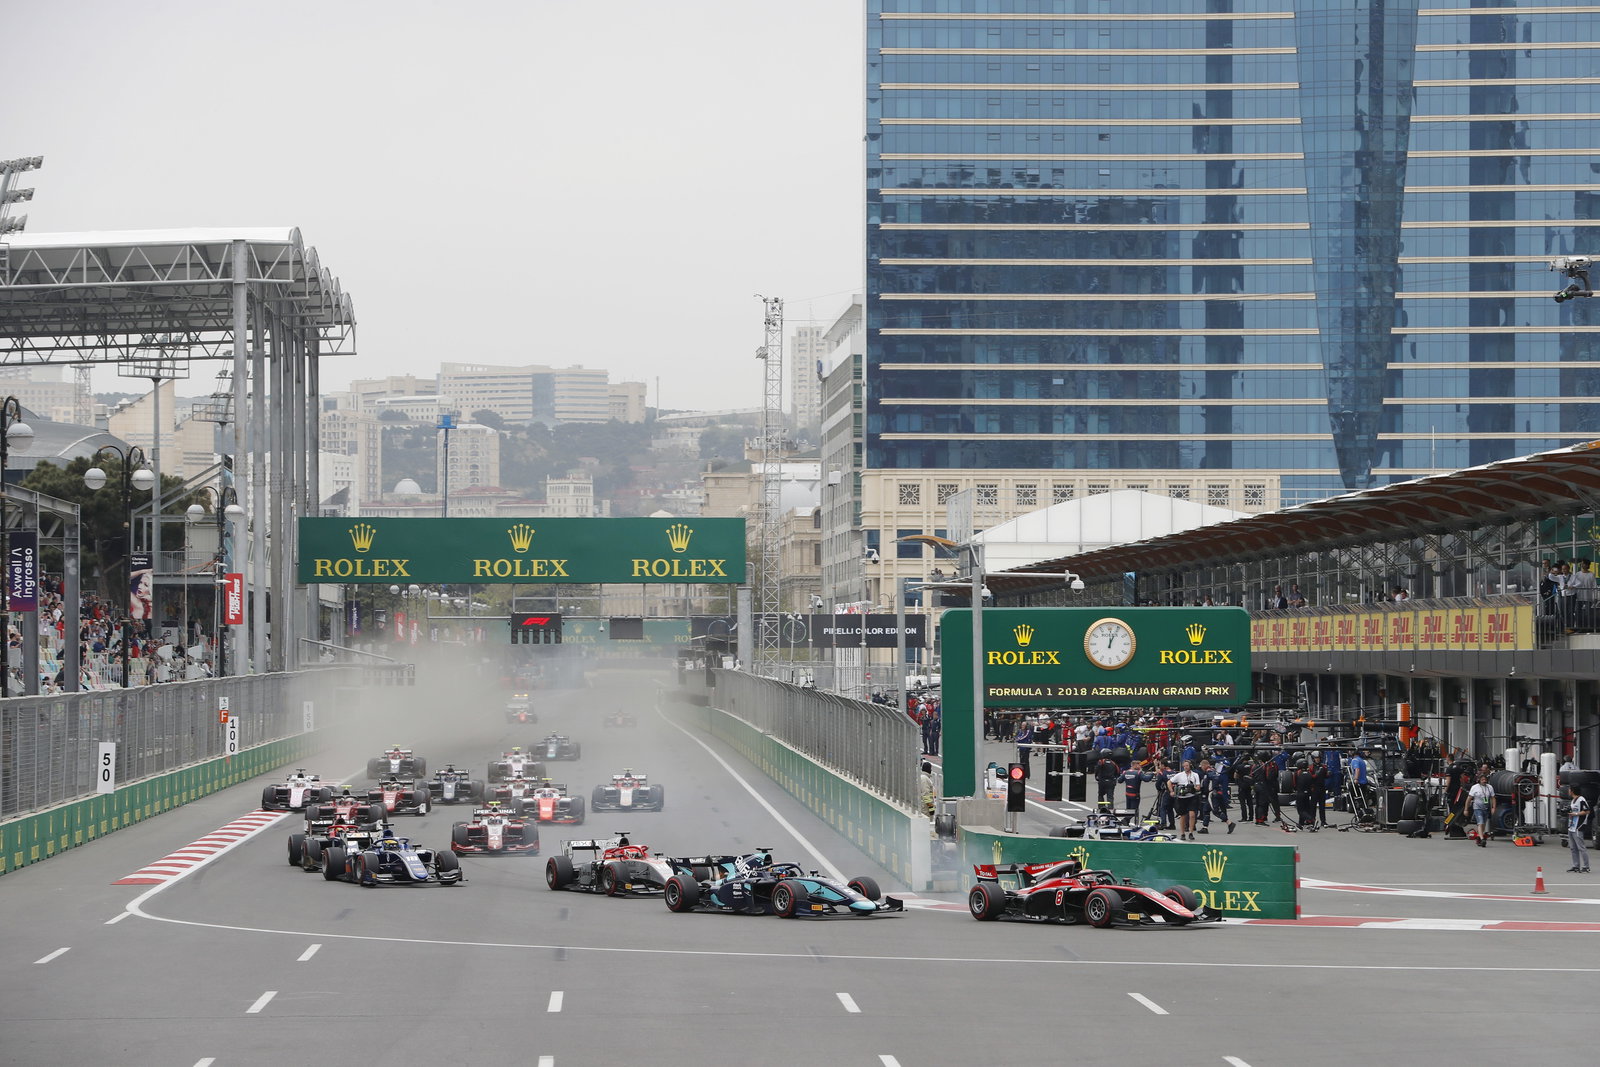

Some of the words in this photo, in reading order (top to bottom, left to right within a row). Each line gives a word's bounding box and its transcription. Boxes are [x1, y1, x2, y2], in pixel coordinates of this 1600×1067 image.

[23, 548, 35, 598] Ingrosso
[314, 559, 410, 577] ROLEX
[473, 559, 569, 577] ROLEX
[632, 559, 728, 577] ROLEX
[12, 561, 22, 598] Axwell
[987, 651, 1061, 665] ROLEX
[1160, 650, 1234, 664] ROLEX
[990, 688, 1042, 696] FORMULA
[1047, 688, 1053, 696] 1
[1058, 688, 1088, 696] 2018
[1092, 687, 1159, 696] AZERBAIJAN
[1163, 687, 1201, 695] GRAND
[1205, 687, 1230, 695] PRIX
[221, 711, 228, 721] F
[1055, 890, 1064, 905] 8
[1193, 890, 1261, 911] OLEX
